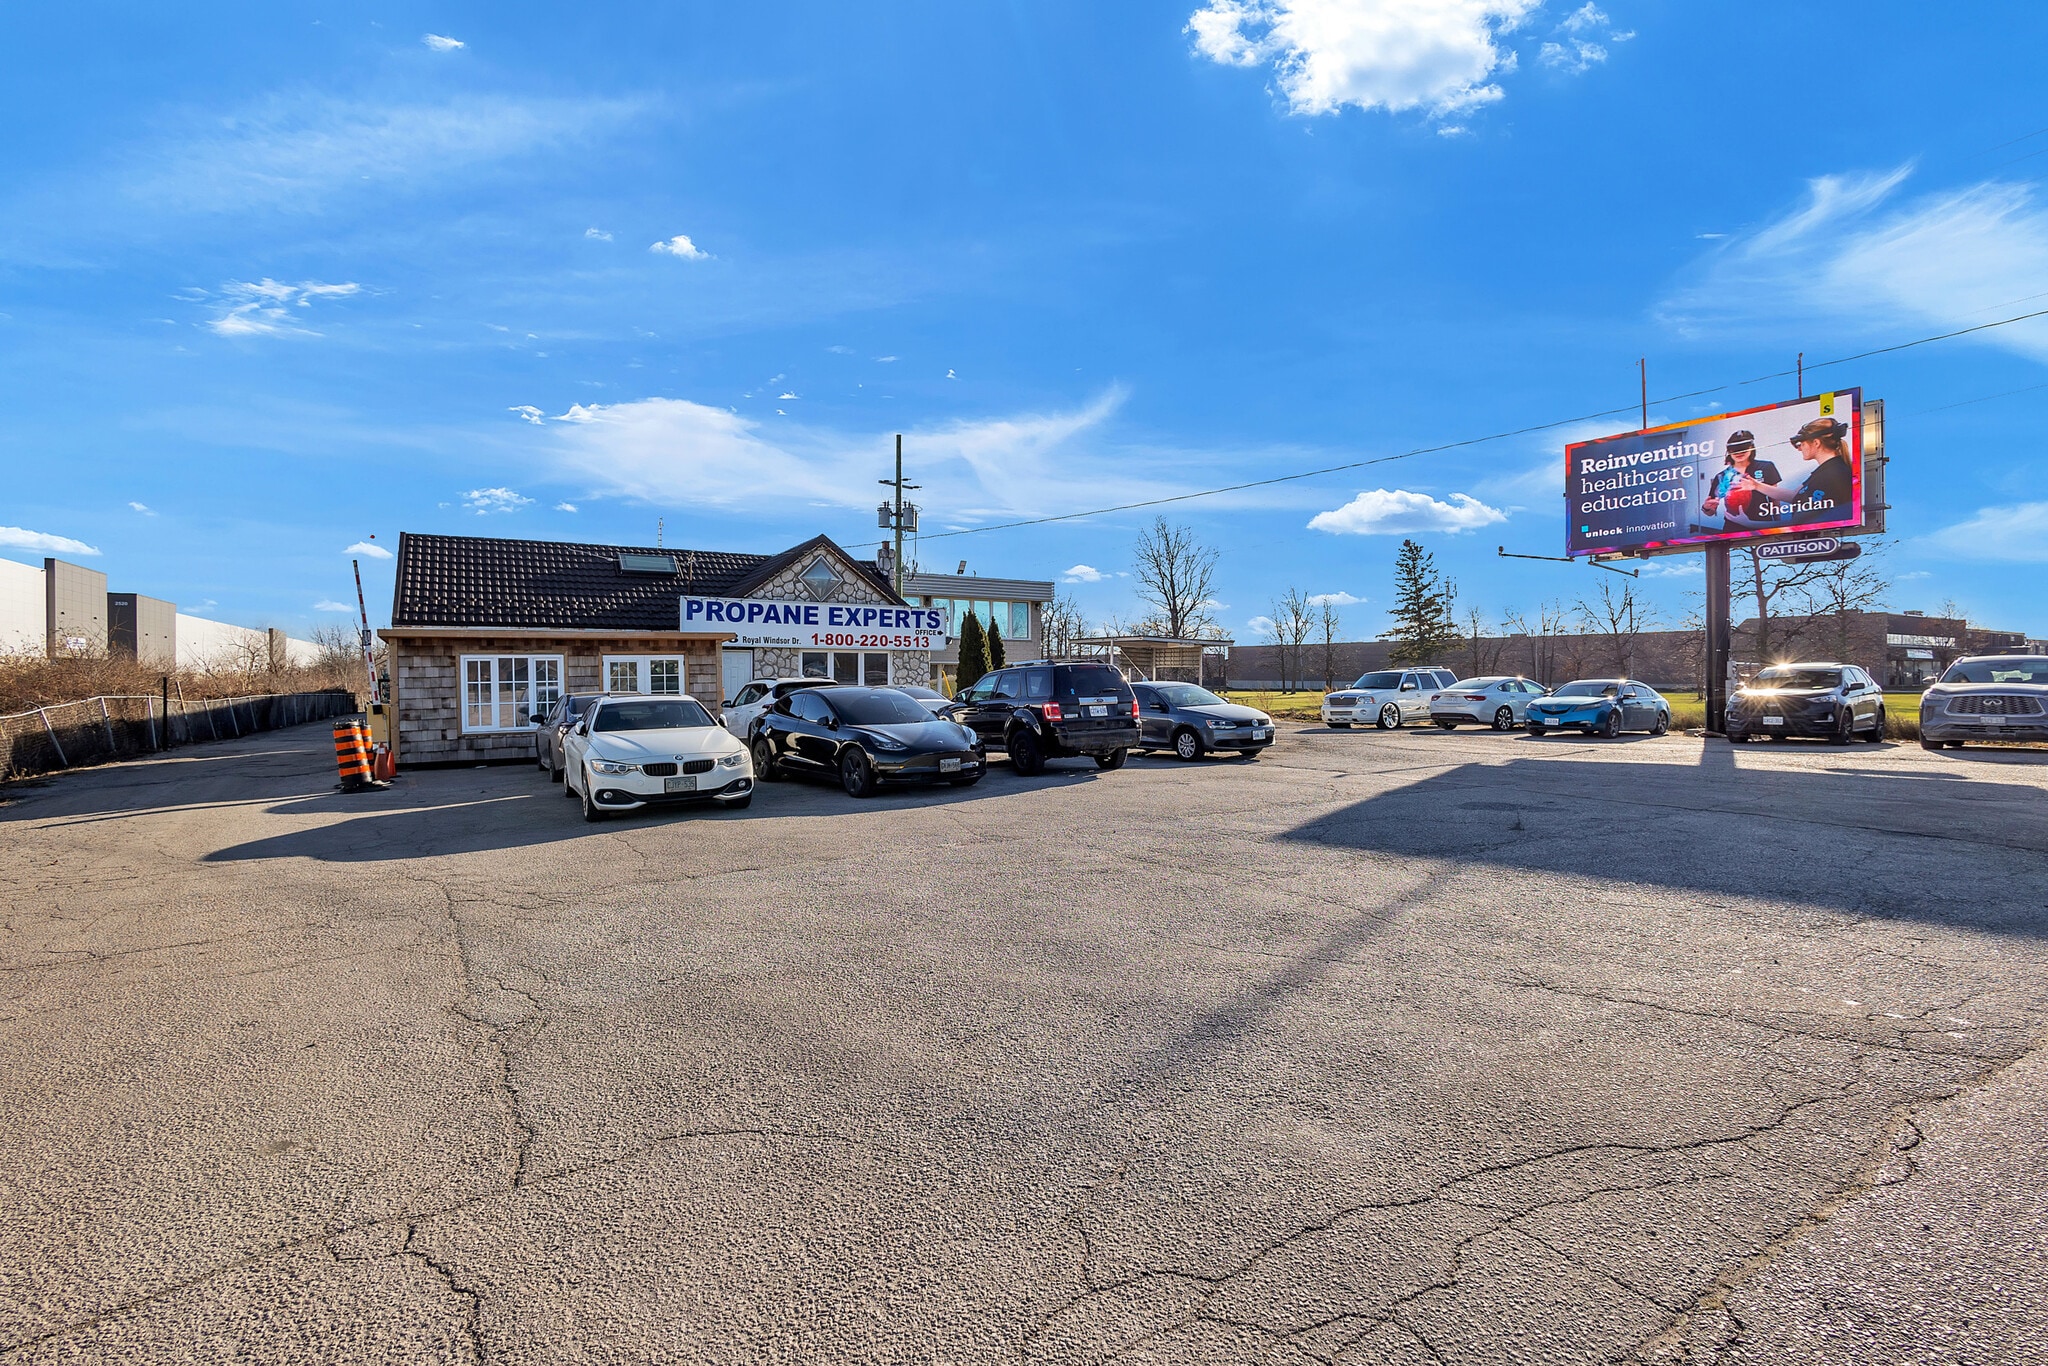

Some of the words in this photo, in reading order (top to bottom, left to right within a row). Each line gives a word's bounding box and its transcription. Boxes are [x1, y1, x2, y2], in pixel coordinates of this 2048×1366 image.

[1580, 440, 1715, 474] Reinventing
[1581, 465, 1694, 494] healthcare
[1581, 487, 1687, 513] education
[1758, 497, 1834, 517] Sheridan
[1585, 527, 1623, 538] unlock
[1626, 521, 1675, 533] innovation
[1763, 541, 1829, 556] PATTISON
[686, 600, 818, 625] PROPANE
[828, 606, 941, 629] EXPERTS
[742, 636, 761, 645] Royal
[763, 636, 791, 645] Windsor
[792, 637, 802, 645] Dr.
[811, 633, 930, 648] 1-800-220-5513
